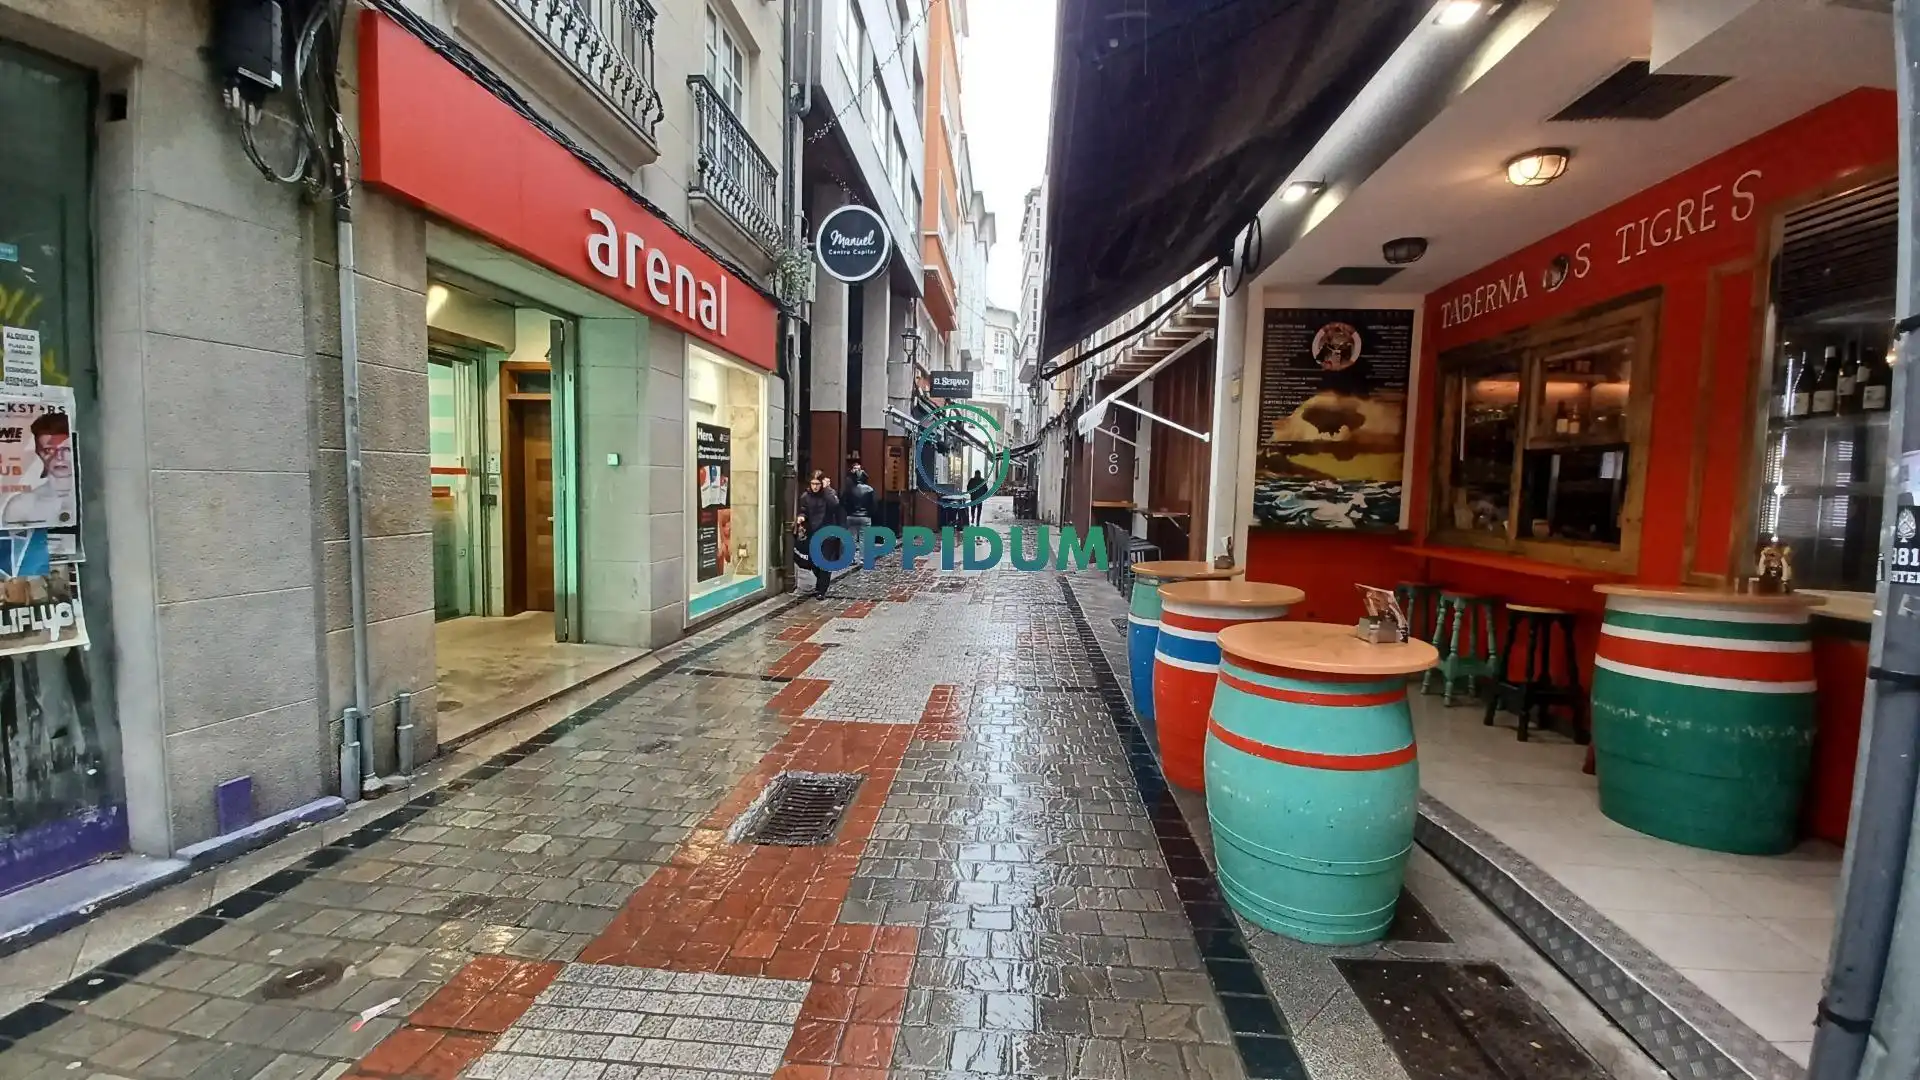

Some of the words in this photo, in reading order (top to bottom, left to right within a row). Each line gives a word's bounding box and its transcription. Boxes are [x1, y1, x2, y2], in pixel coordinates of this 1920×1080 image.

[586, 208, 728, 337] arenal
[830, 229, 875, 249] Manuel
[1441, 271, 1529, 329] TABERNA
[1615, 169, 1762, 265] TIGRES
[697, 427, 714, 442] Hero.
